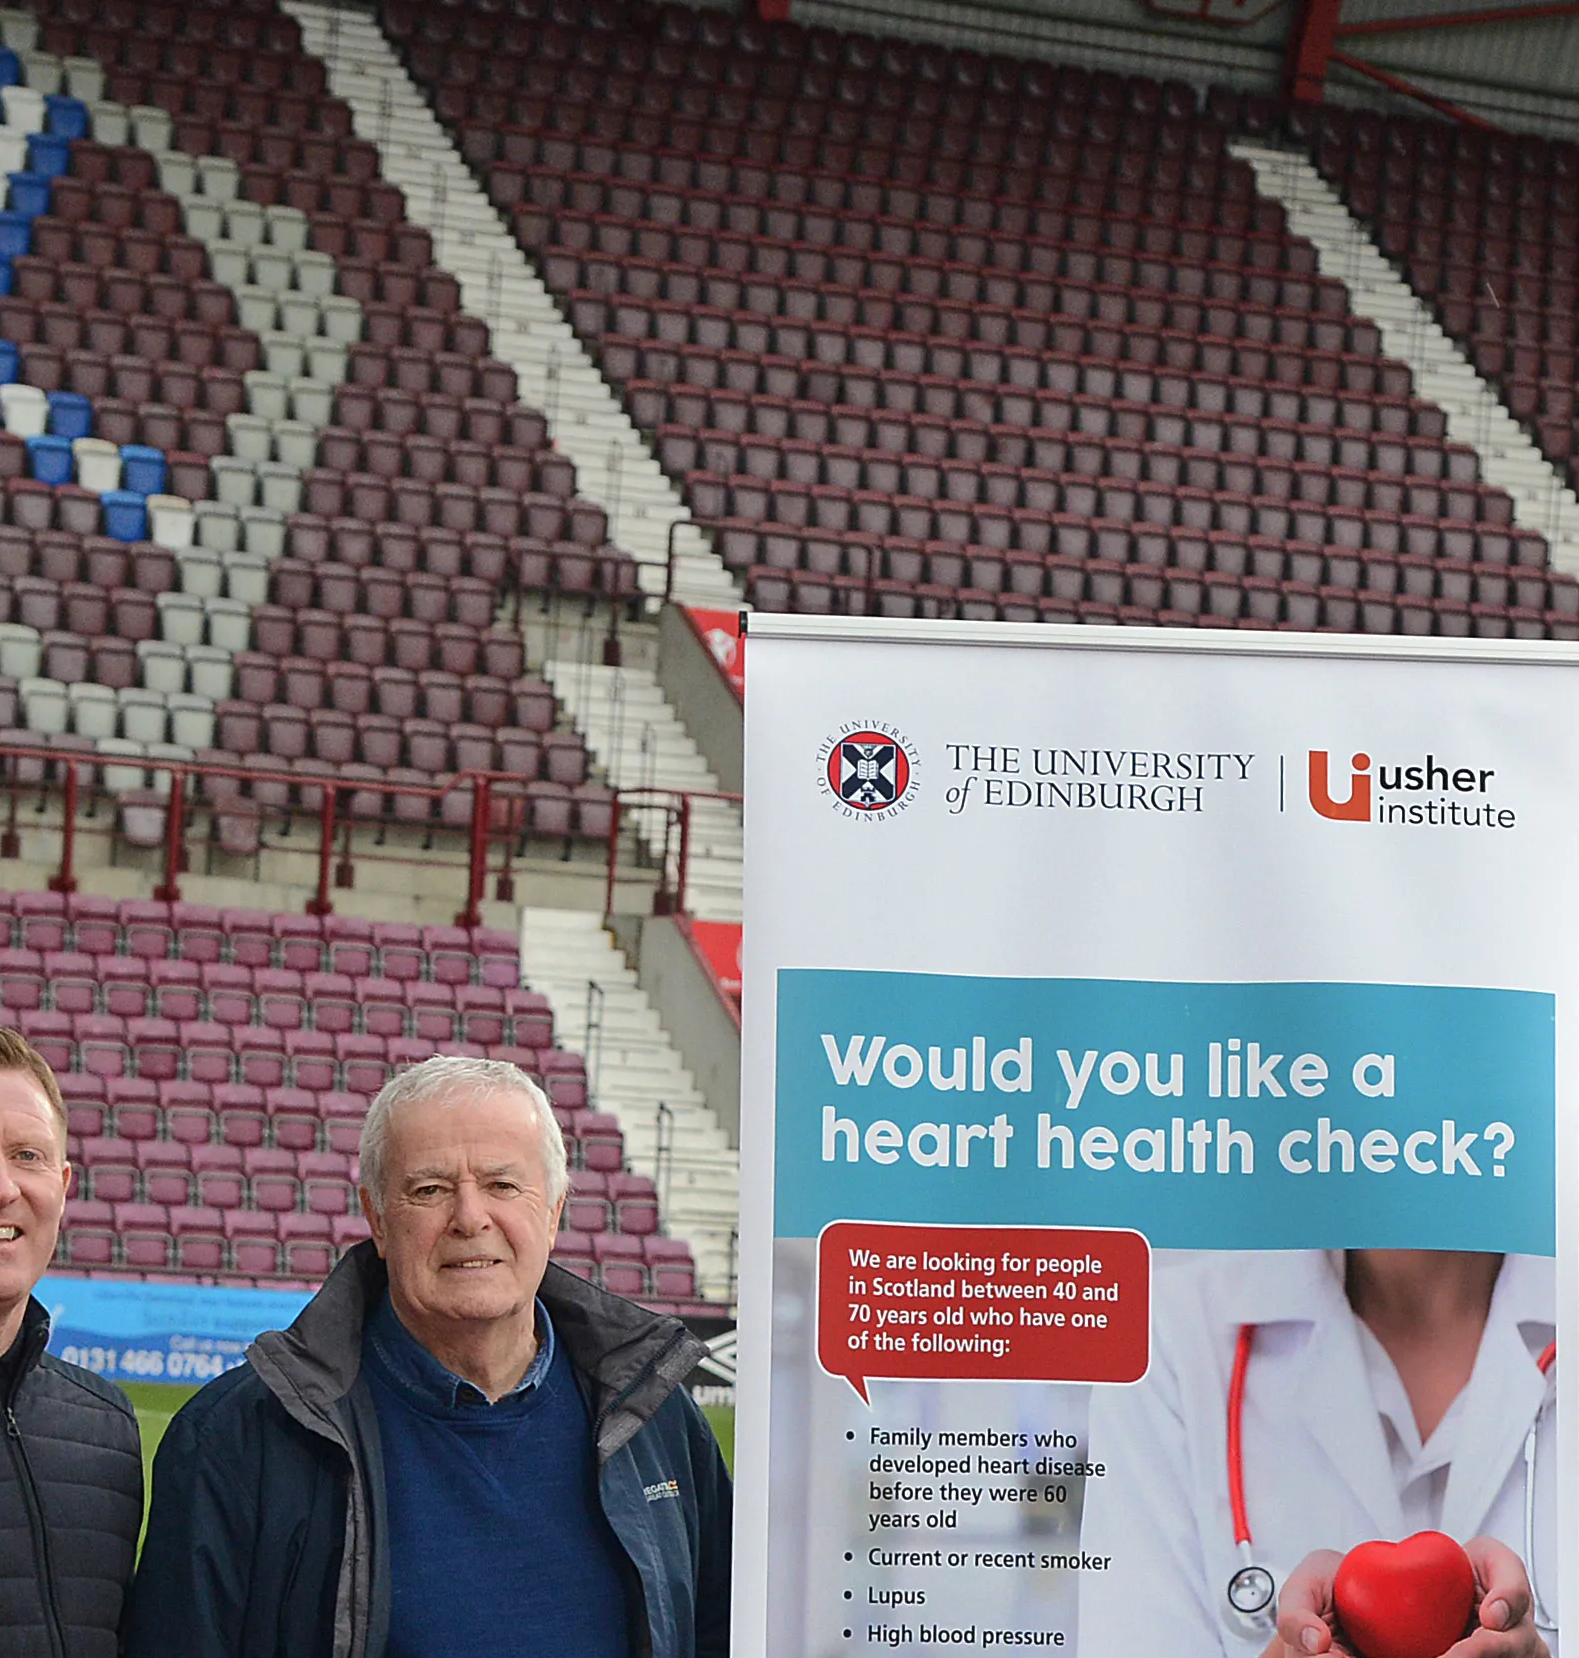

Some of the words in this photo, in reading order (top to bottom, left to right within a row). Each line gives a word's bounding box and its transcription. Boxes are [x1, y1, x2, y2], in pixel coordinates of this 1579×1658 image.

[816, 734, 837, 761] THE
[839, 720, 922, 767] UNIVERSITY
[946, 744, 1020, 774] THE
[1033, 749, 1254, 780] UNIVERSITY
[1379, 755, 1495, 793] usher
[817, 777, 831, 796] OF
[832, 781, 921, 822] EDINBURGH
[945, 776, 978, 814] of
[985, 779, 1202, 812] EDINBURGH
[1379, 797, 1516, 829] institute
[820, 1034, 1033, 1093] Would
[1056, 1049, 1184, 1110] you
[1208, 1038, 1329, 1098] like
[1352, 1053, 1395, 1098] a
[821, 1105, 1014, 1168] heart
[1037, 1113, 1254, 1174] health
[1278, 1117, 1515, 1178] check?
[848, 1248, 881, 1269] We
[886, 1255, 917, 1270] are
[923, 1251, 995, 1276] looking
[1001, 1252, 1031, 1272] for
[1036, 1254, 1102, 1278] people
[849, 1275, 866, 1295] in
[872, 1277, 955, 1298] Scotland
[961, 1279, 1047, 1299] between
[1052, 1281, 1077, 1300] 40
[1082, 1282, 1118, 1302] and
[848, 1303, 871, 1323] 70
[876, 1309, 928, 1328] years
[933, 1306, 964, 1326] old
[969, 1306, 1014, 1326] who
[1019, 1306, 1066, 1327] have
[1071, 1313, 1108, 1329] one
[847, 1330, 869, 1350] of
[873, 1331, 906, 1352] the
[911, 1332, 1010, 1358] following:
[61, 1346, 117, 1373] 0131
[120, 1350, 164, 1375] 466
[167, 1352, 224, 1378] 0764
[870, 1427, 932, 1451] Family
[938, 1428, 1028, 1448] members
[1034, 1429, 1077, 1449] who
[869, 1453, 971, 1478] developed
[978, 1455, 1030, 1475] heart
[1035, 1456, 1106, 1477] disease
[869, 1480, 933, 1501] before
[939, 1482, 983, 1506] they
[989, 1488, 1038, 1503] were
[1044, 1484, 1067, 1503] 60
[868, 1513, 920, 1532] years
[926, 1509, 957, 1528] old
[868, 1547, 942, 1567] Current
[947, 1553, 969, 1567] or
[974, 1551, 1036, 1569] recent
[1040, 1551, 1112, 1570] smoker
[868, 1586, 926, 1609] Lupus
[868, 1624, 913, 1648] High
[920, 1624, 976, 1644] blood
[982, 1630, 1065, 1649] pressure
